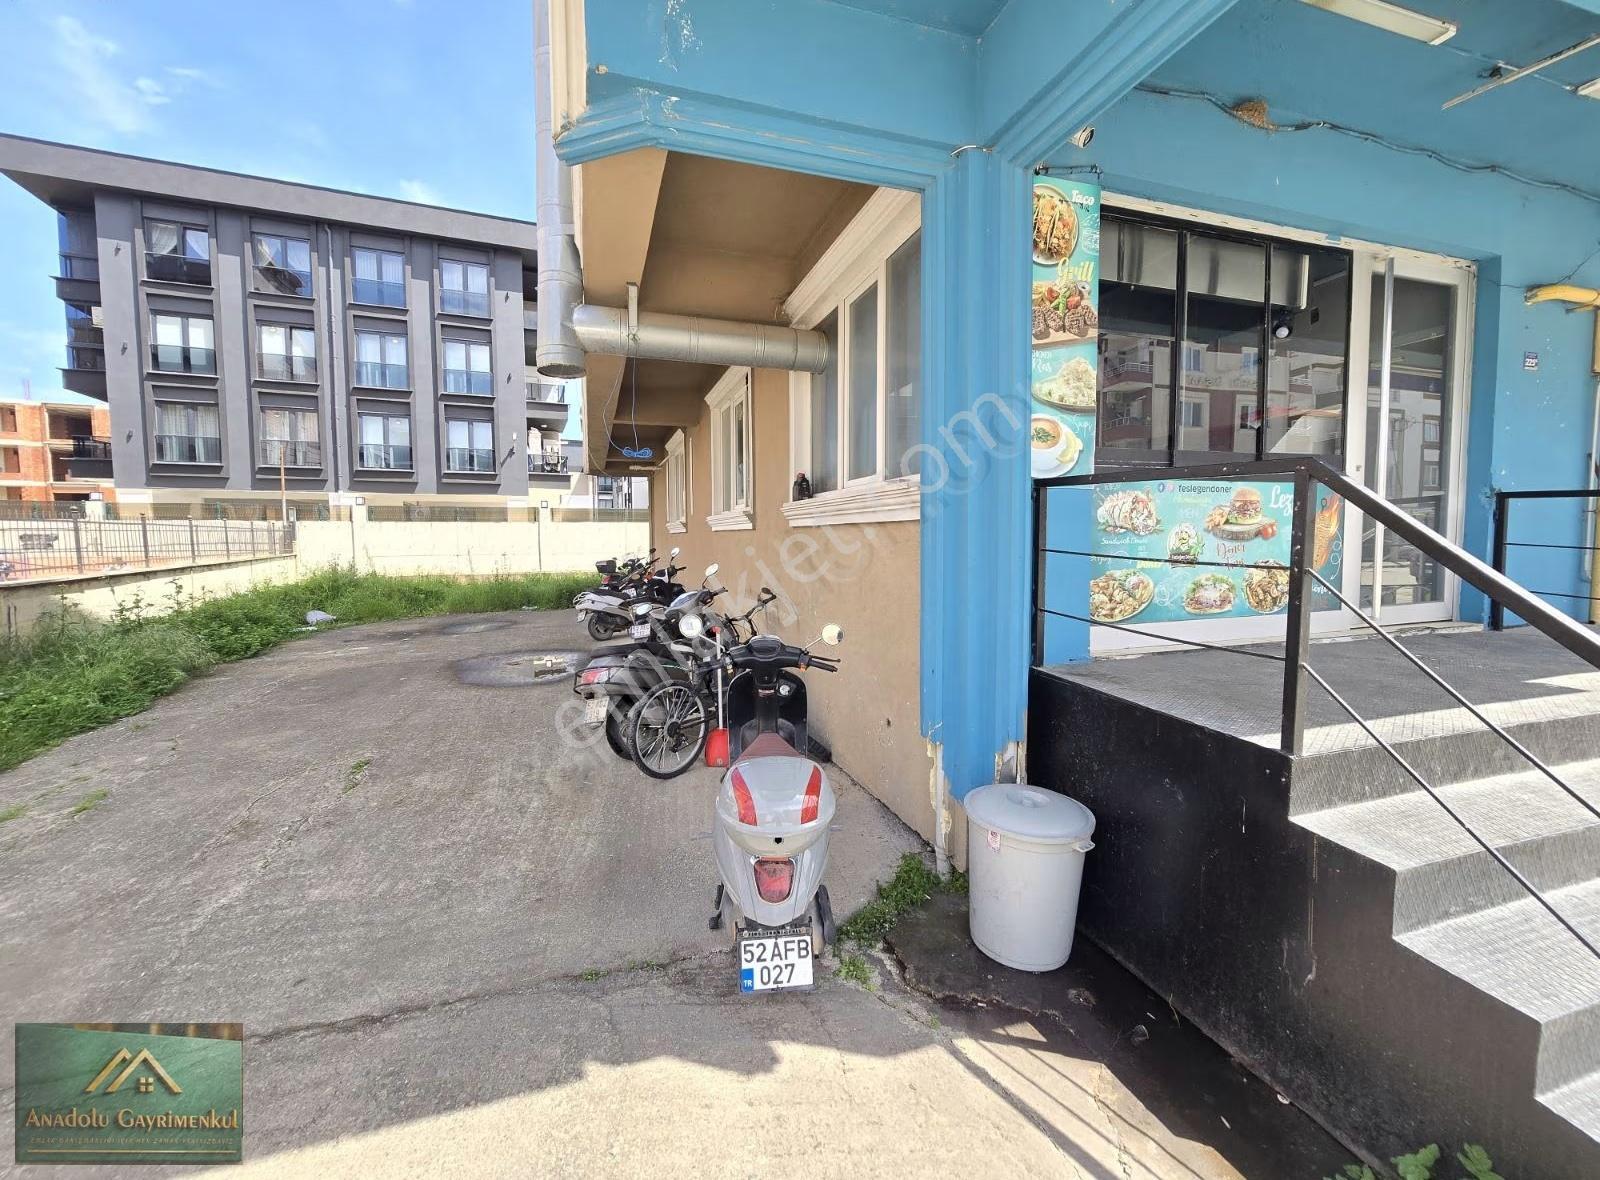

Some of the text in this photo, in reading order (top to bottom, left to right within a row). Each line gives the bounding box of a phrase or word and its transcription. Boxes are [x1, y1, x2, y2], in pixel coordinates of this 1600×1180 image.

[1071, 189, 1095, 206] Taco
[760, 963, 795, 986] 027
[743, 979, 753, 988] TR
